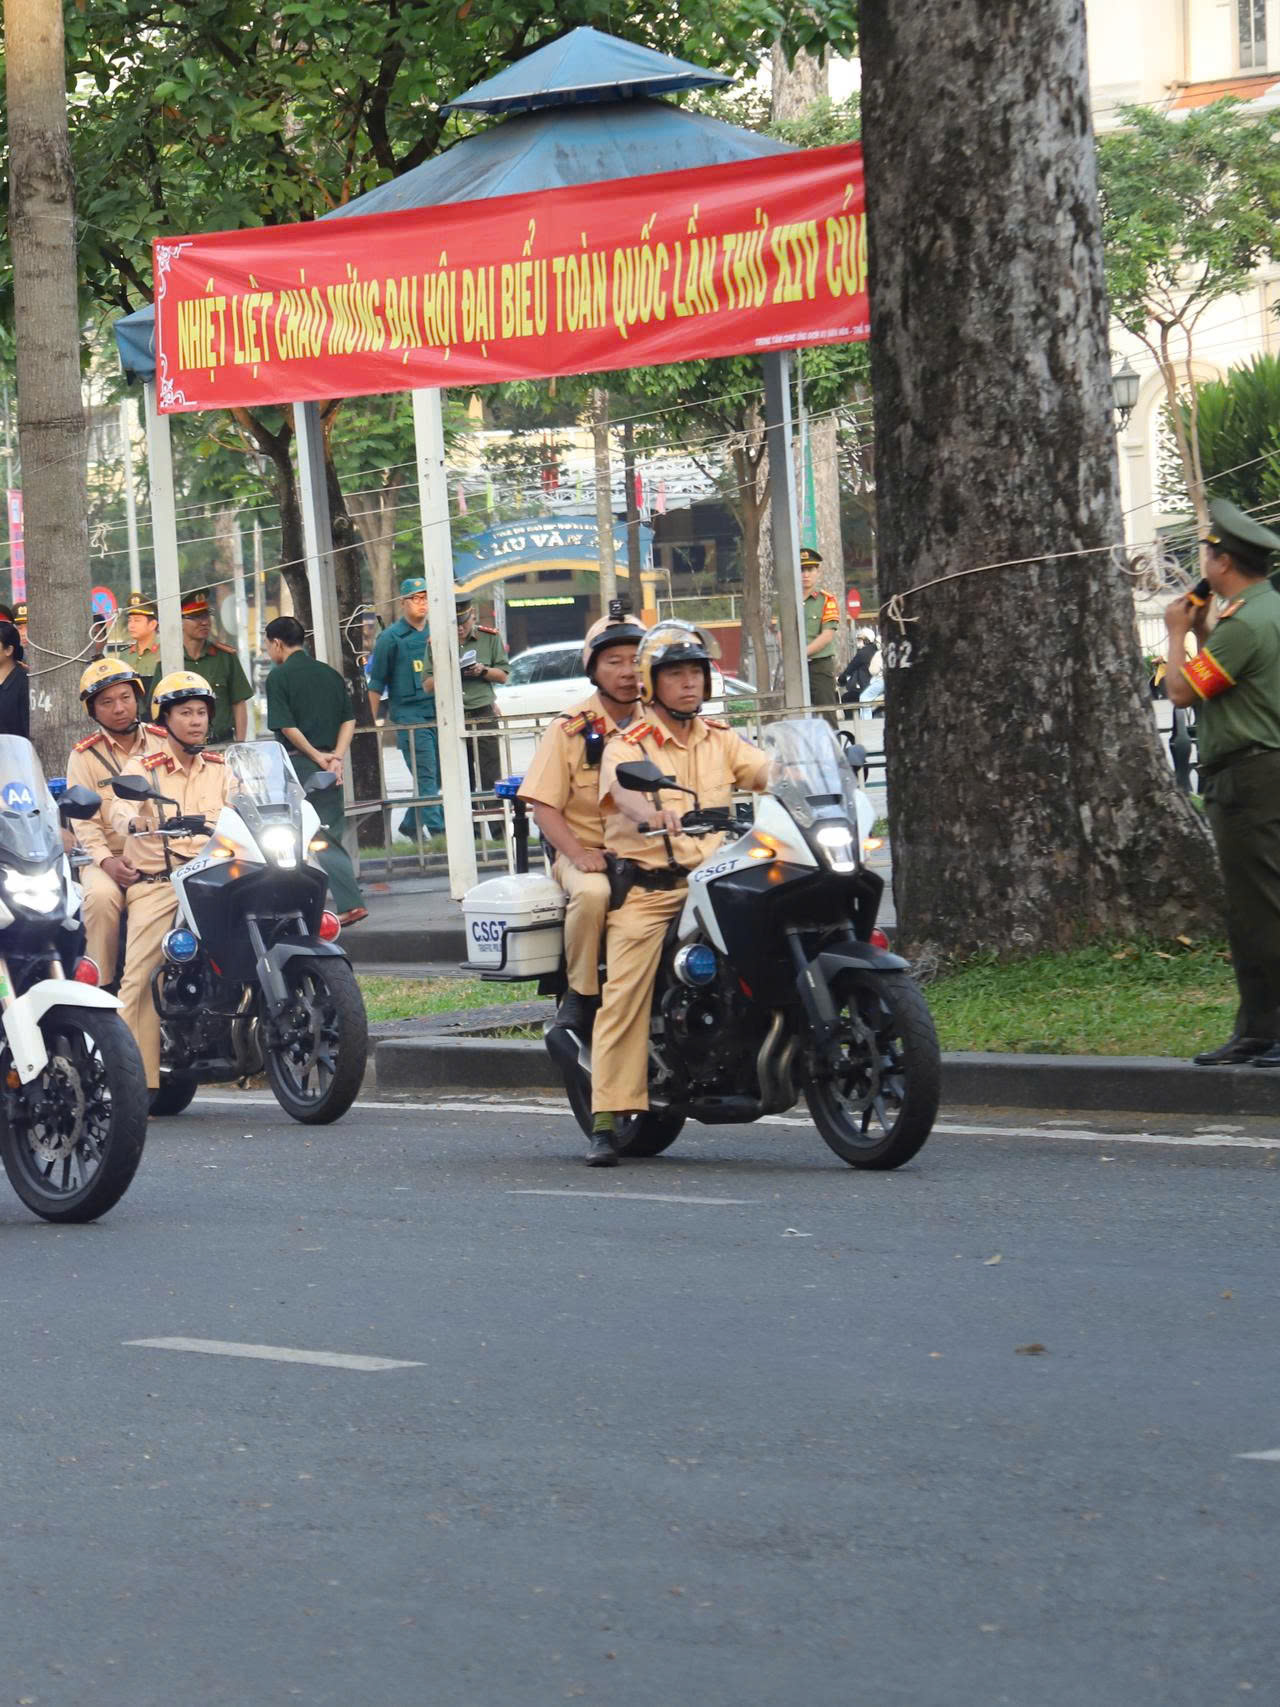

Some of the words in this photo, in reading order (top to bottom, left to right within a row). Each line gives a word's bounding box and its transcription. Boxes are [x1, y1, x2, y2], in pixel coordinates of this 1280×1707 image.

[178, 278, 226, 383] NHIỆT
[232, 274, 273, 379] LIỆT
[275, 268, 328, 361] CHÀO
[327, 263, 385, 355] MỪNG
[385, 275, 422, 364] ĐẠI
[423, 251, 458, 360] HỘI
[461, 266, 495, 358] ĐẠI
[501, 218, 547, 340] BIỂU
[552, 232, 607, 332] TOÀN
[613, 213, 669, 340] QUỐC
[673, 203, 719, 317] LẦN
[771, 220, 819, 304] XIV
[8, 788, 33, 805] A4
[177, 859, 209, 877] CSGT
[694, 859, 739, 882] CSGT
